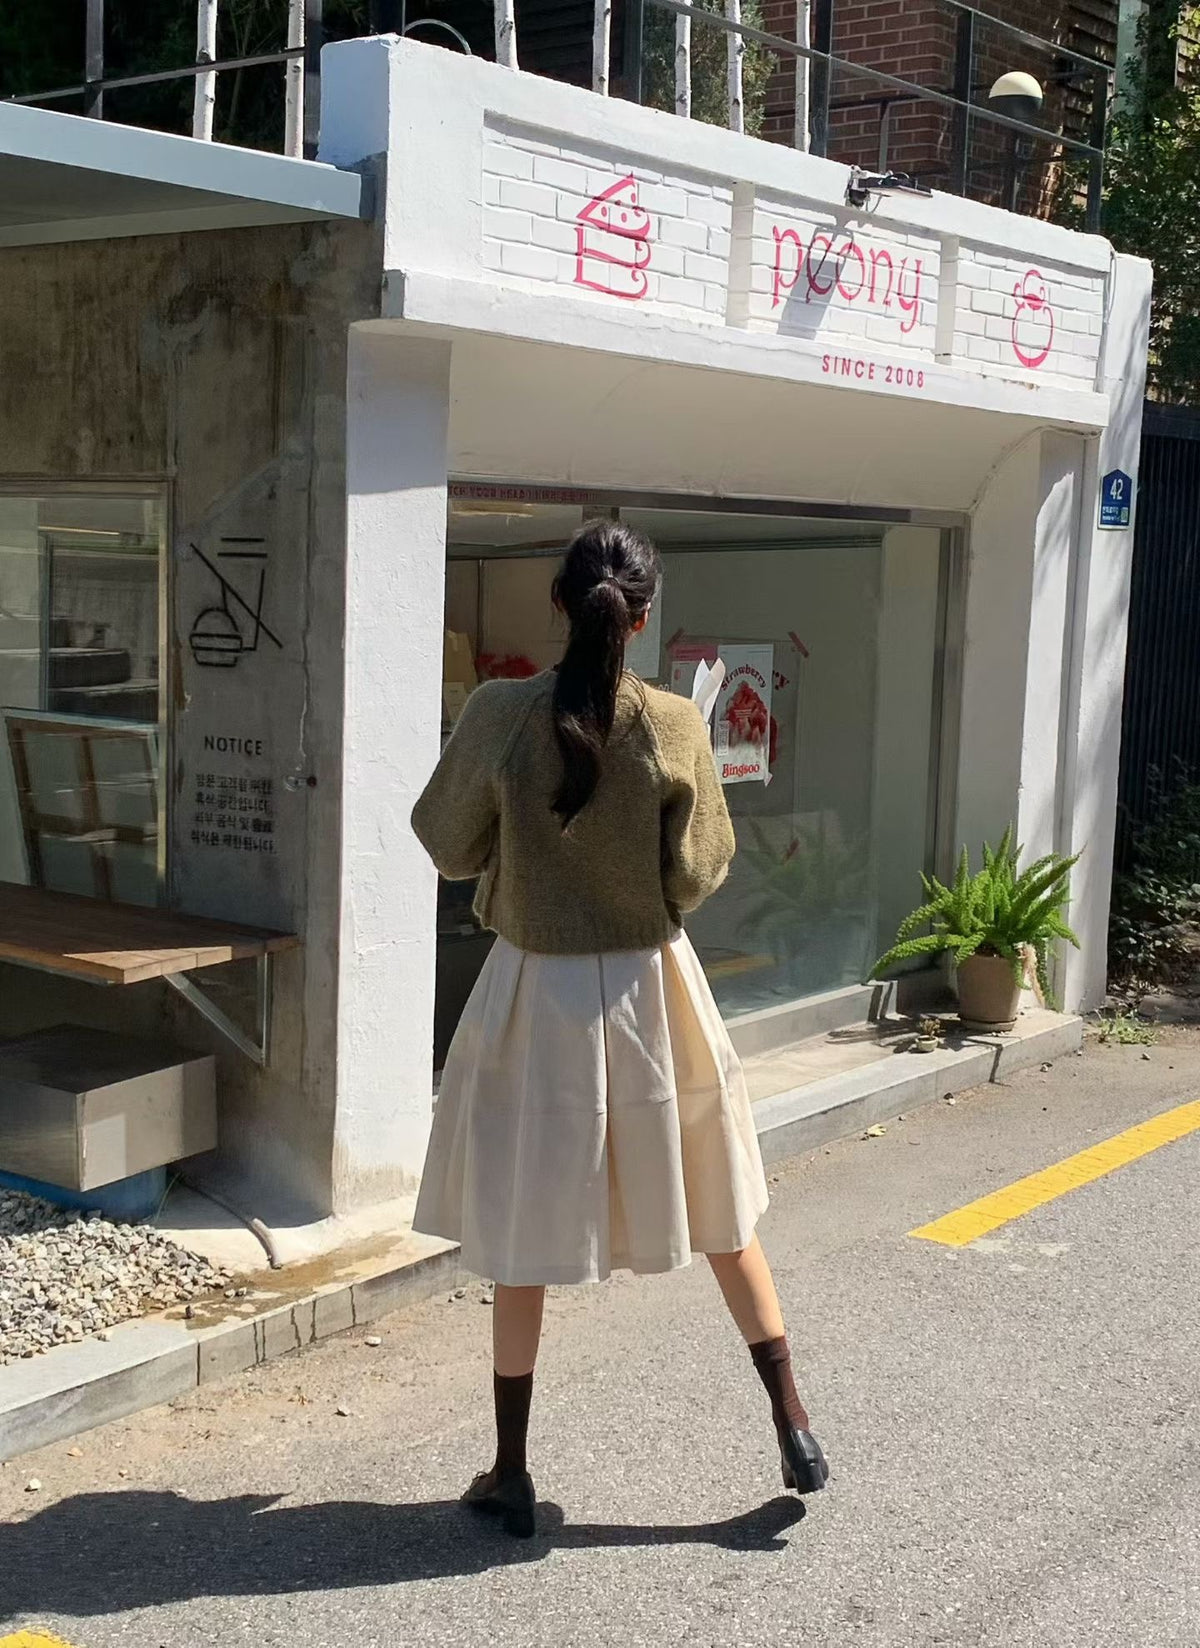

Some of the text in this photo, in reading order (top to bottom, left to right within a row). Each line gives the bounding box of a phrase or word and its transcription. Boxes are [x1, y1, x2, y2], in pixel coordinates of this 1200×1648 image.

[771, 225, 923, 333] peony
[822, 354, 925, 388] SINCE 2008
[1110, 478, 1124, 500] 42
[721, 664, 767, 691] Strawberry
[204, 735, 263, 755] NOTICE
[722, 762, 760, 778] Bingsoo
